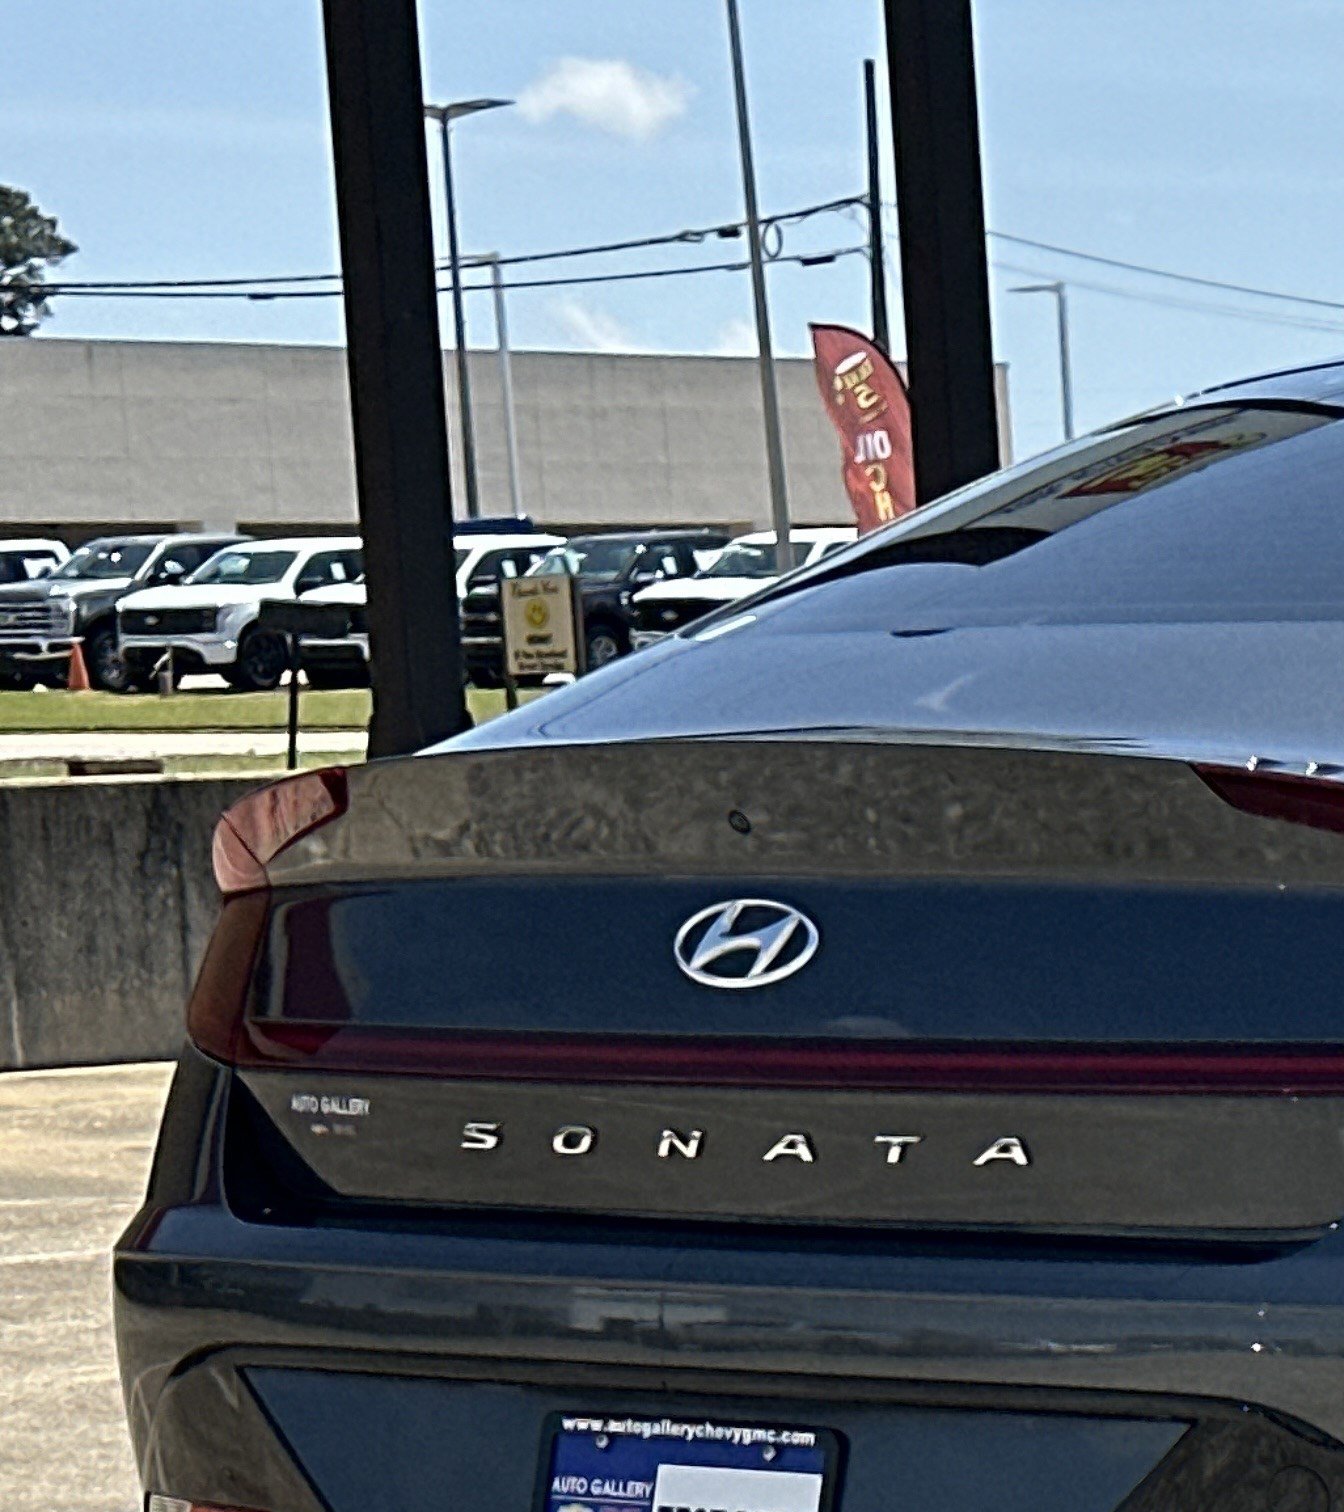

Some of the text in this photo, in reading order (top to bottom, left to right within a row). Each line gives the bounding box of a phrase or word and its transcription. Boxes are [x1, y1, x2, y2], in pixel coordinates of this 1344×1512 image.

[460, 1120, 1033, 1168] SONATA
[561, 1417, 816, 1446] www.autogallerychevygmc.com
[551, 1476, 654, 1499] AUTO GALLERY
